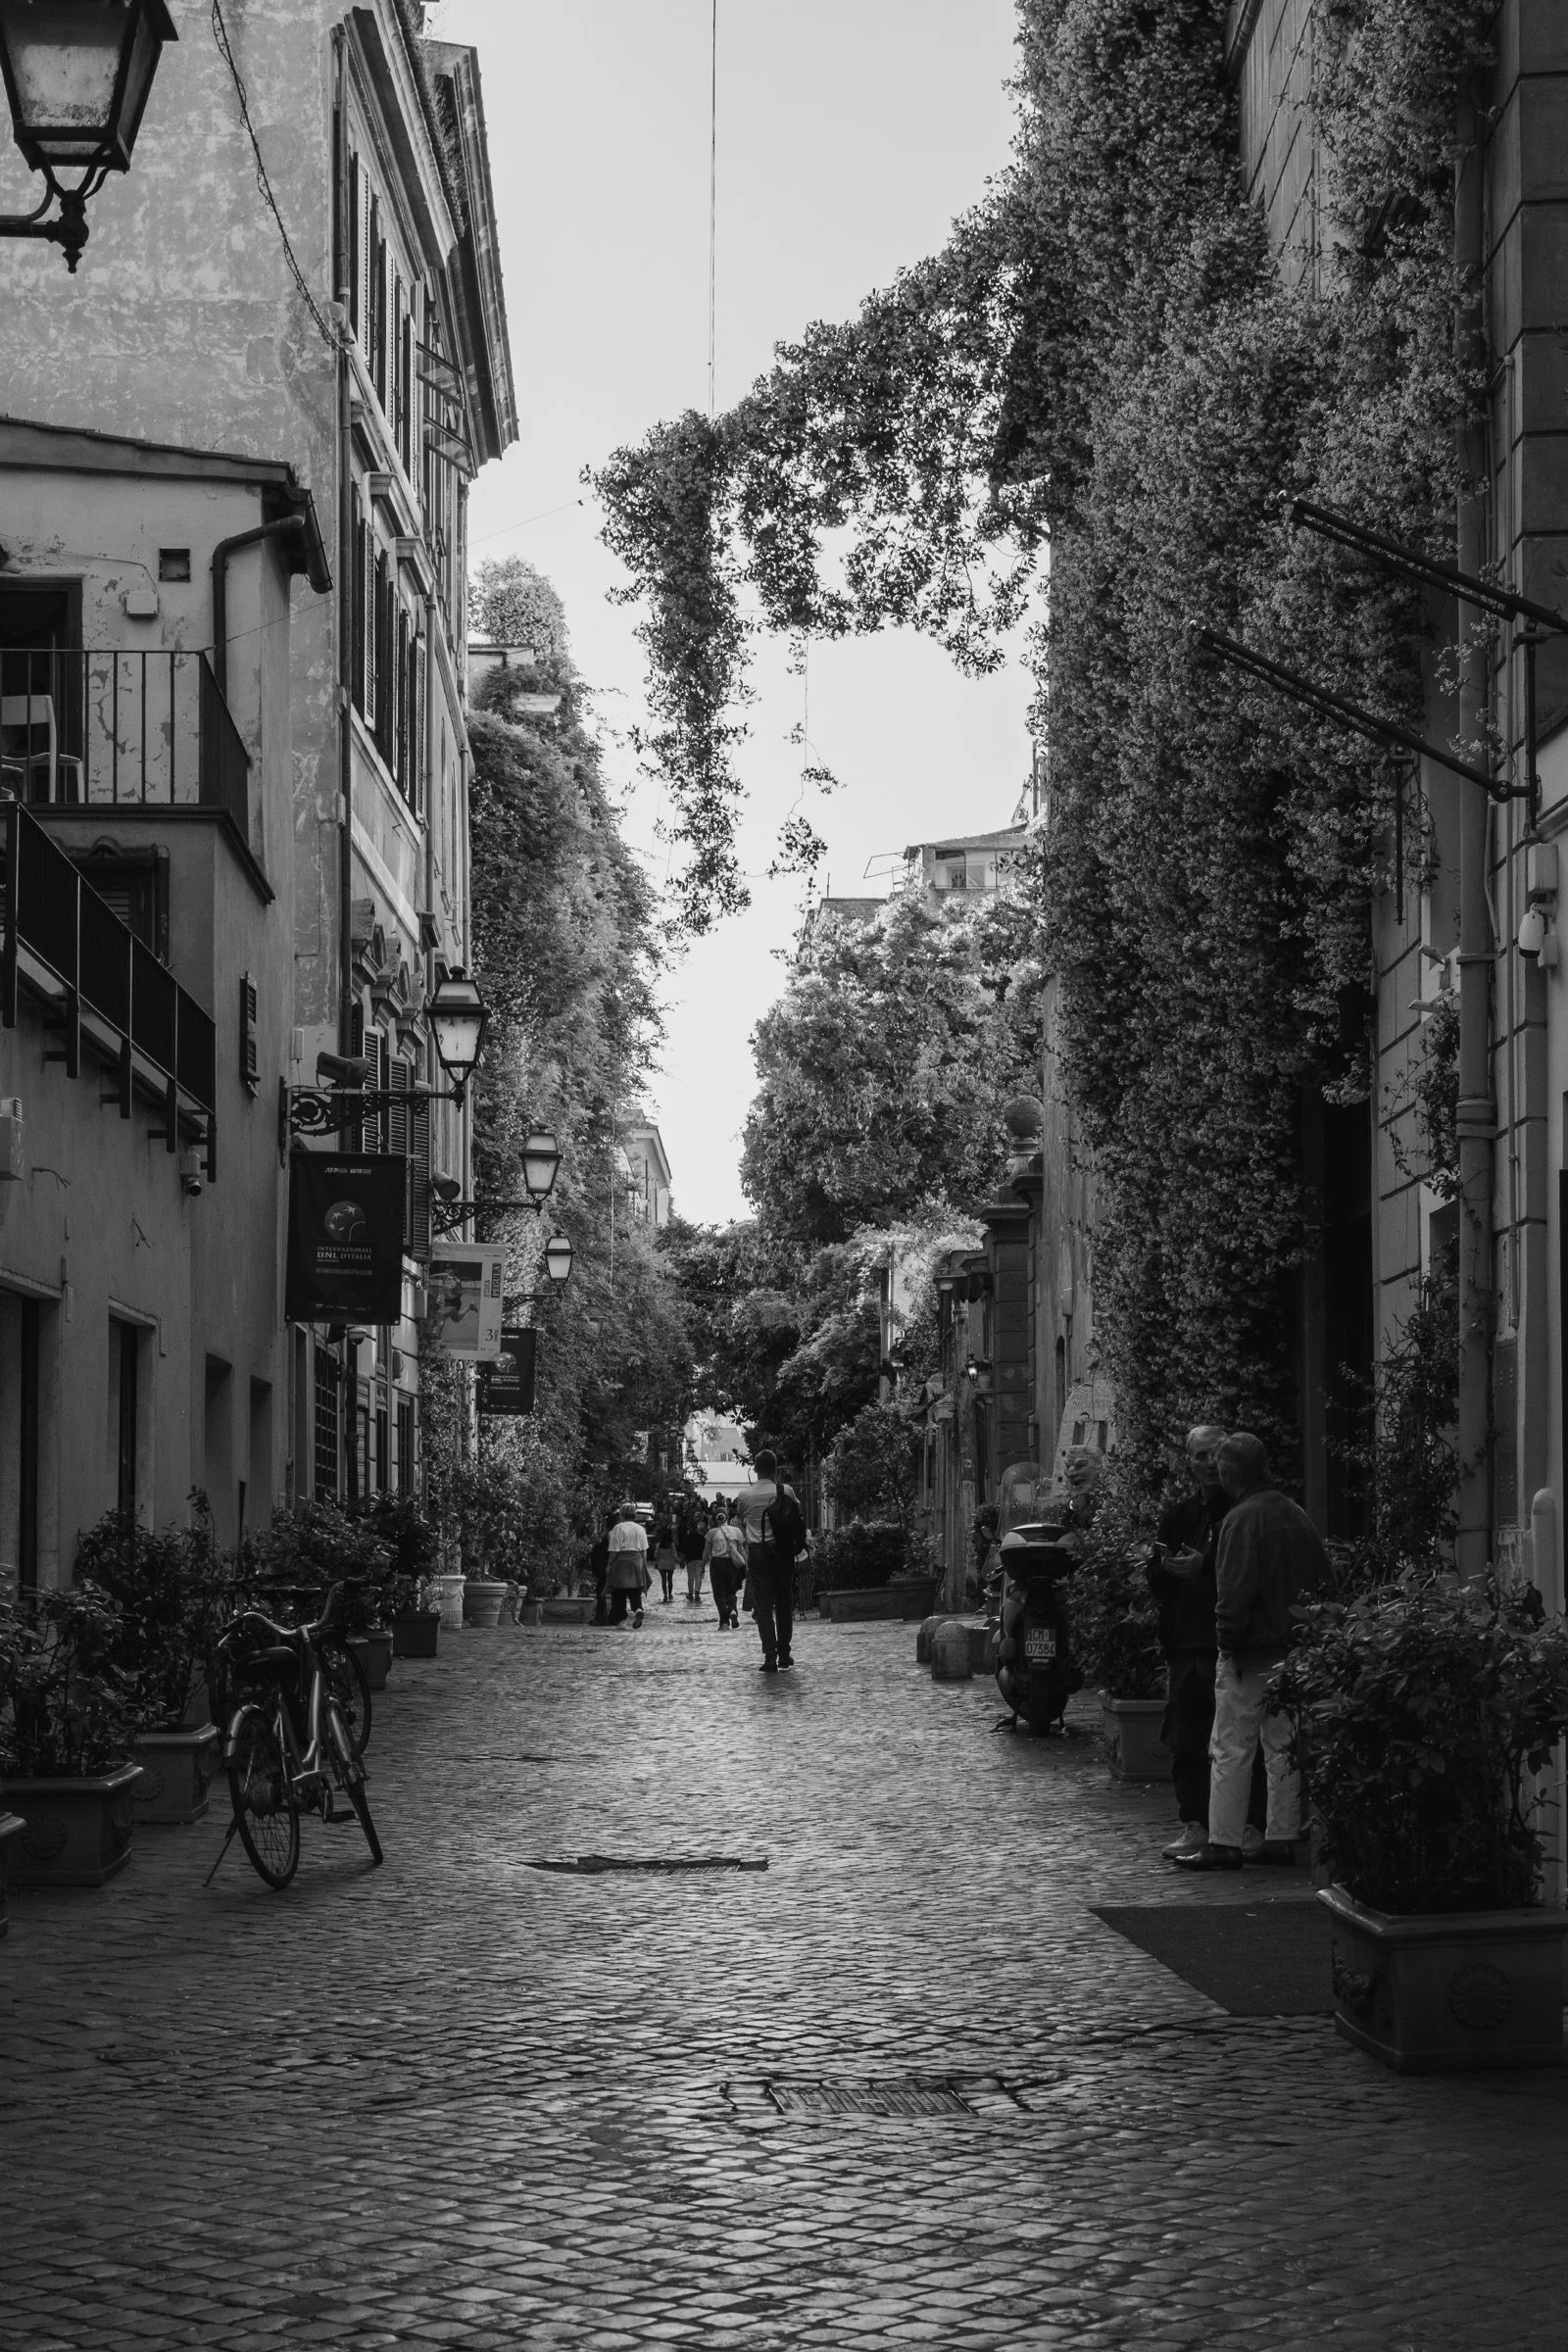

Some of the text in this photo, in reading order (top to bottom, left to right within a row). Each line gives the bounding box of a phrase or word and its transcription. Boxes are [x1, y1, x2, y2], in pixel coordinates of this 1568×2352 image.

[492, 1265, 501, 1298] PEGULA
[485, 1329, 493, 1342] 3
[1026, 1642, 1054, 1655] 07384
